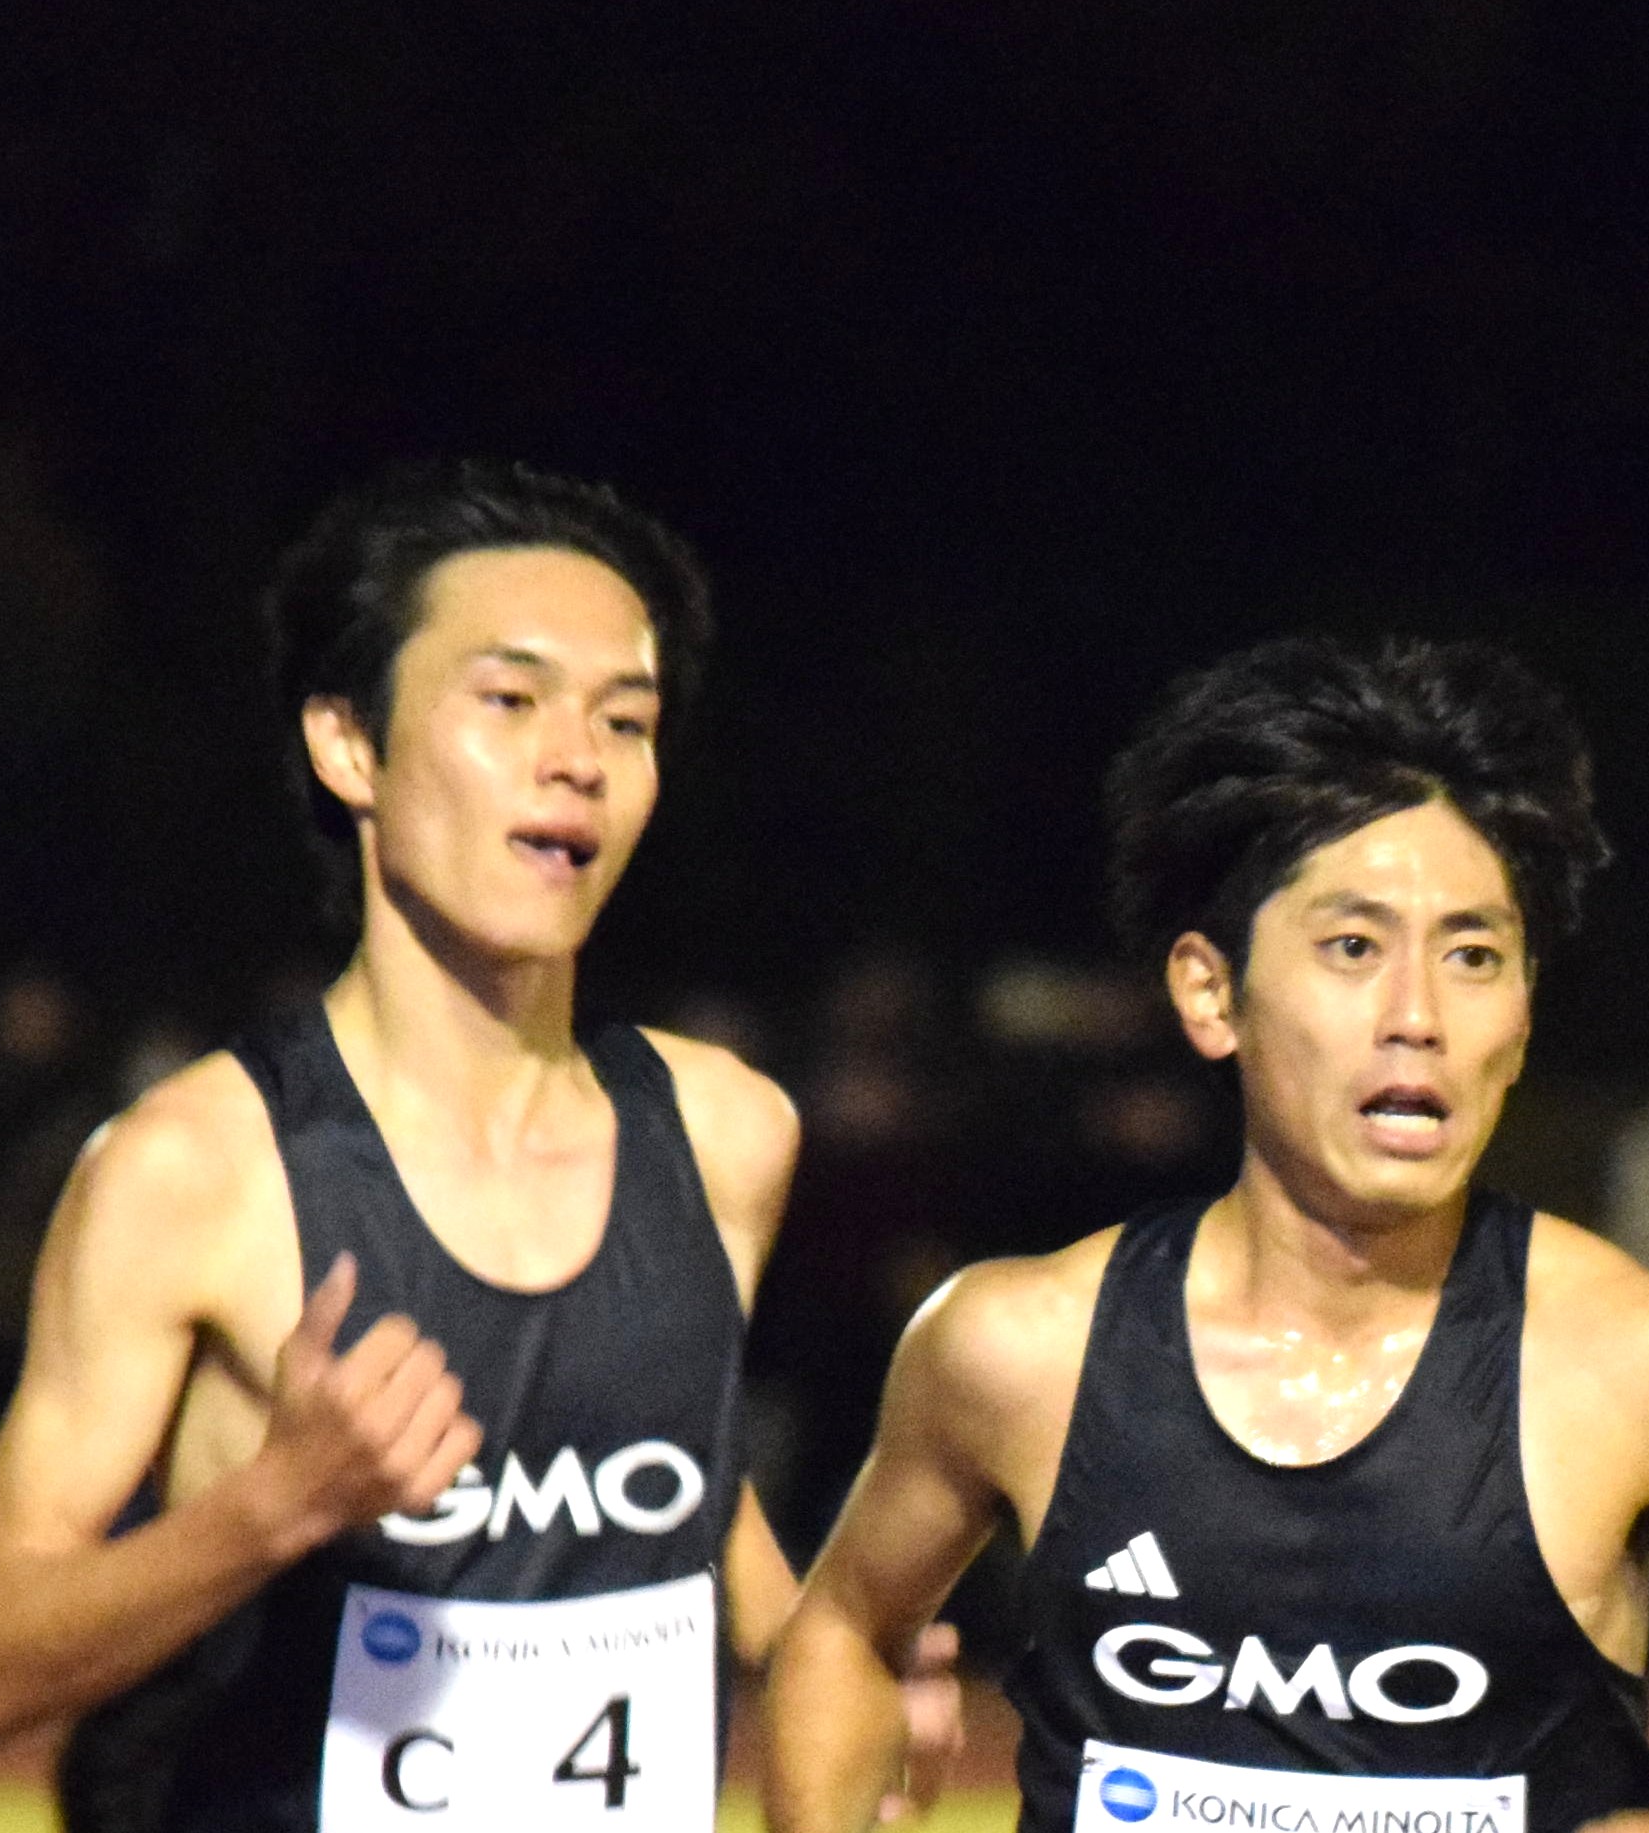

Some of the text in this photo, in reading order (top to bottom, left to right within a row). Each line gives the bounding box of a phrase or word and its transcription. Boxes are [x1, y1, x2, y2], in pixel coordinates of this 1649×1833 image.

[1091, 1623, 1489, 1724] GMO
[381, 1690, 642, 1812] C 4
[1172, 1790, 1320, 1833] KONICA
